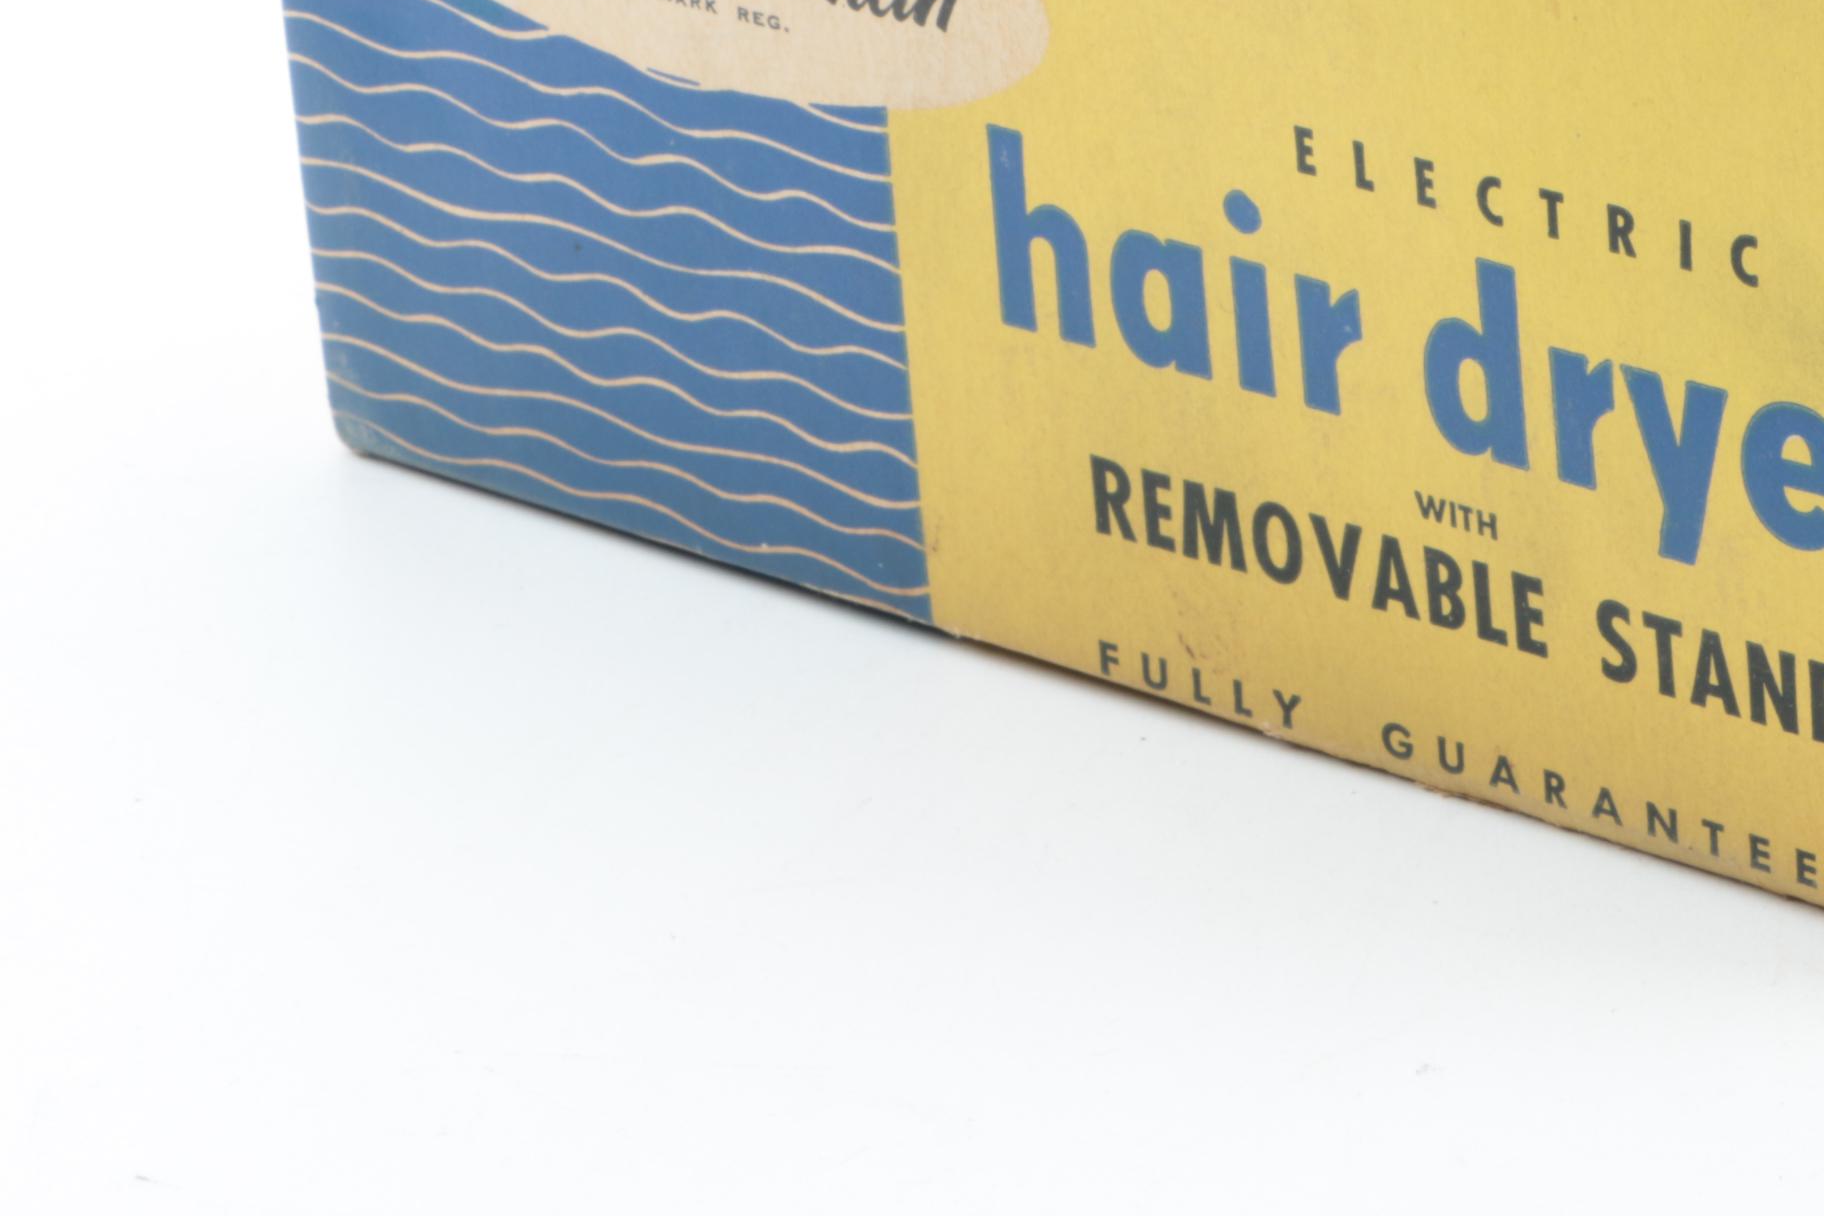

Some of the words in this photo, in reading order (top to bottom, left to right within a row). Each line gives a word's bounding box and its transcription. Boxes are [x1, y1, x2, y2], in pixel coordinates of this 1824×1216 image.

[736, 7, 790, 33] REG.
[986, 123, 1362, 415] hair
[1293, 124, 1760, 288] ELECTRIC
[1089, 454, 1549, 660] REMOVABLE
[1414, 490, 1498, 541] WITH
[1098, 640, 1302, 730] FULLY
